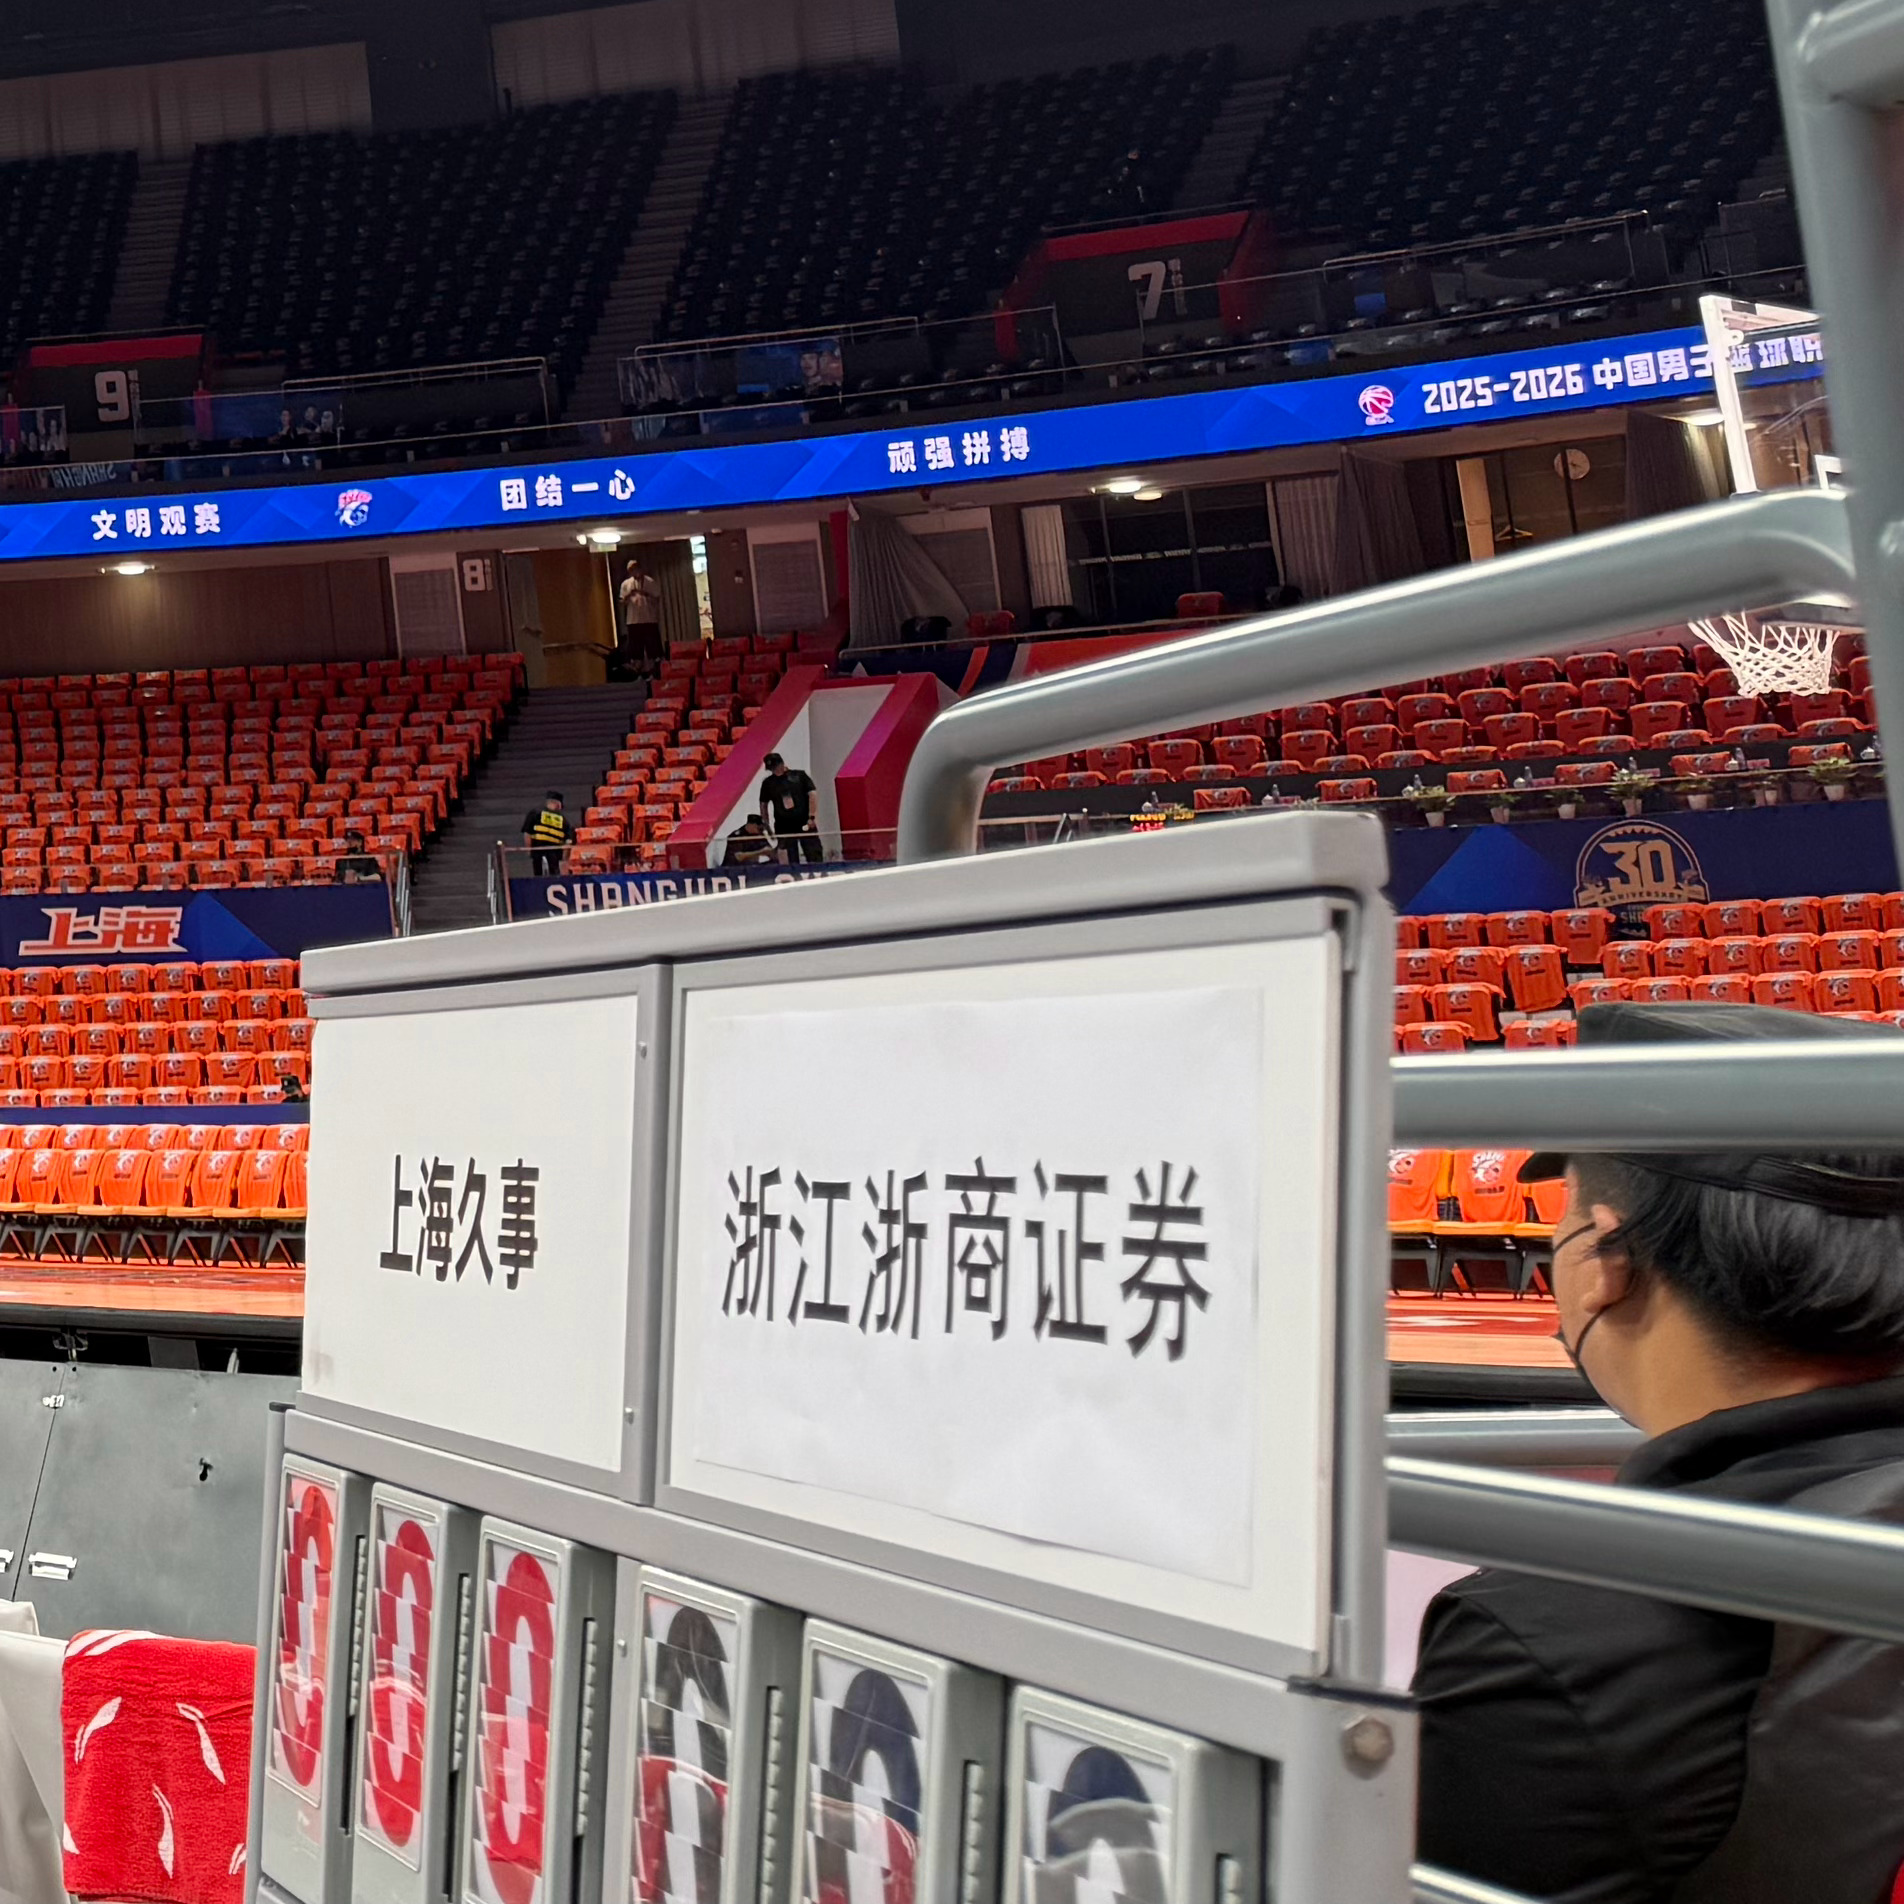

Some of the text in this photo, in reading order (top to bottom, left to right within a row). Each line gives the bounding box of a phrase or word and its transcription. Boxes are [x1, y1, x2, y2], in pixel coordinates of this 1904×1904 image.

[1129, 262, 1159, 321] 7
[93, 371, 132, 423] 9
[1421, 363, 1585, 414] 2025-2026
[887, 426, 1030, 473] 顽强拼搏
[499, 469, 636, 511] 团结一心
[91, 503, 221, 541] 文明观赛
[462, 558, 485, 593] 8
[1598, 838, 1677, 894] 30
[19, 905, 187, 957] 上海
[379, 1154, 542, 1292] 上海久事
[720, 1155, 1212, 1362] 浙江浙商证券
